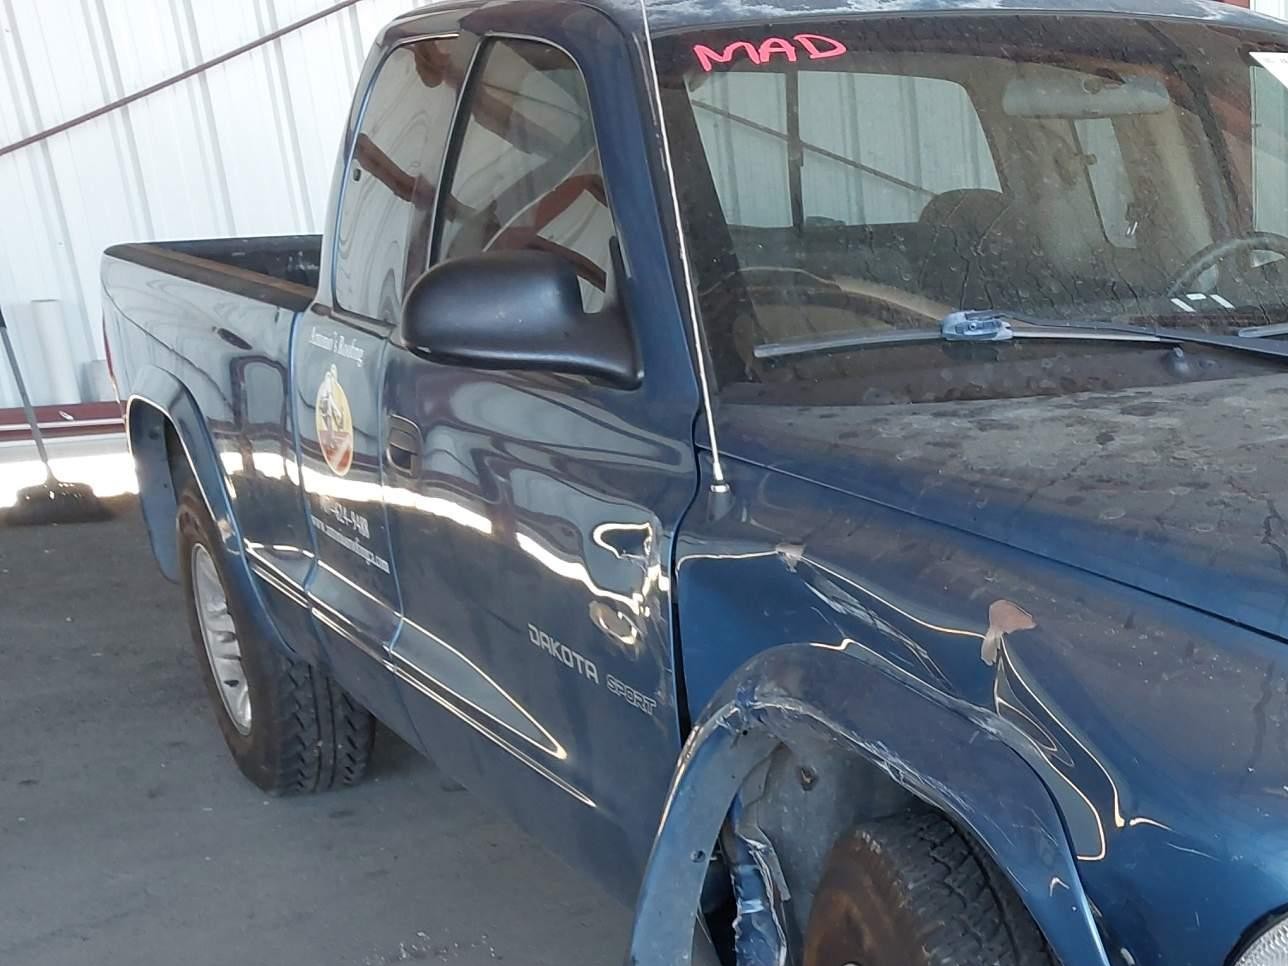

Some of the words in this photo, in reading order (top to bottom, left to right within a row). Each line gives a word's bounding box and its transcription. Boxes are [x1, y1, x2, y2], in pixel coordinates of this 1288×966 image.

[693, 34, 847, 71] MAD
[528, 622, 600, 684] DAKOTA
[606, 674, 657, 716] SPORT
